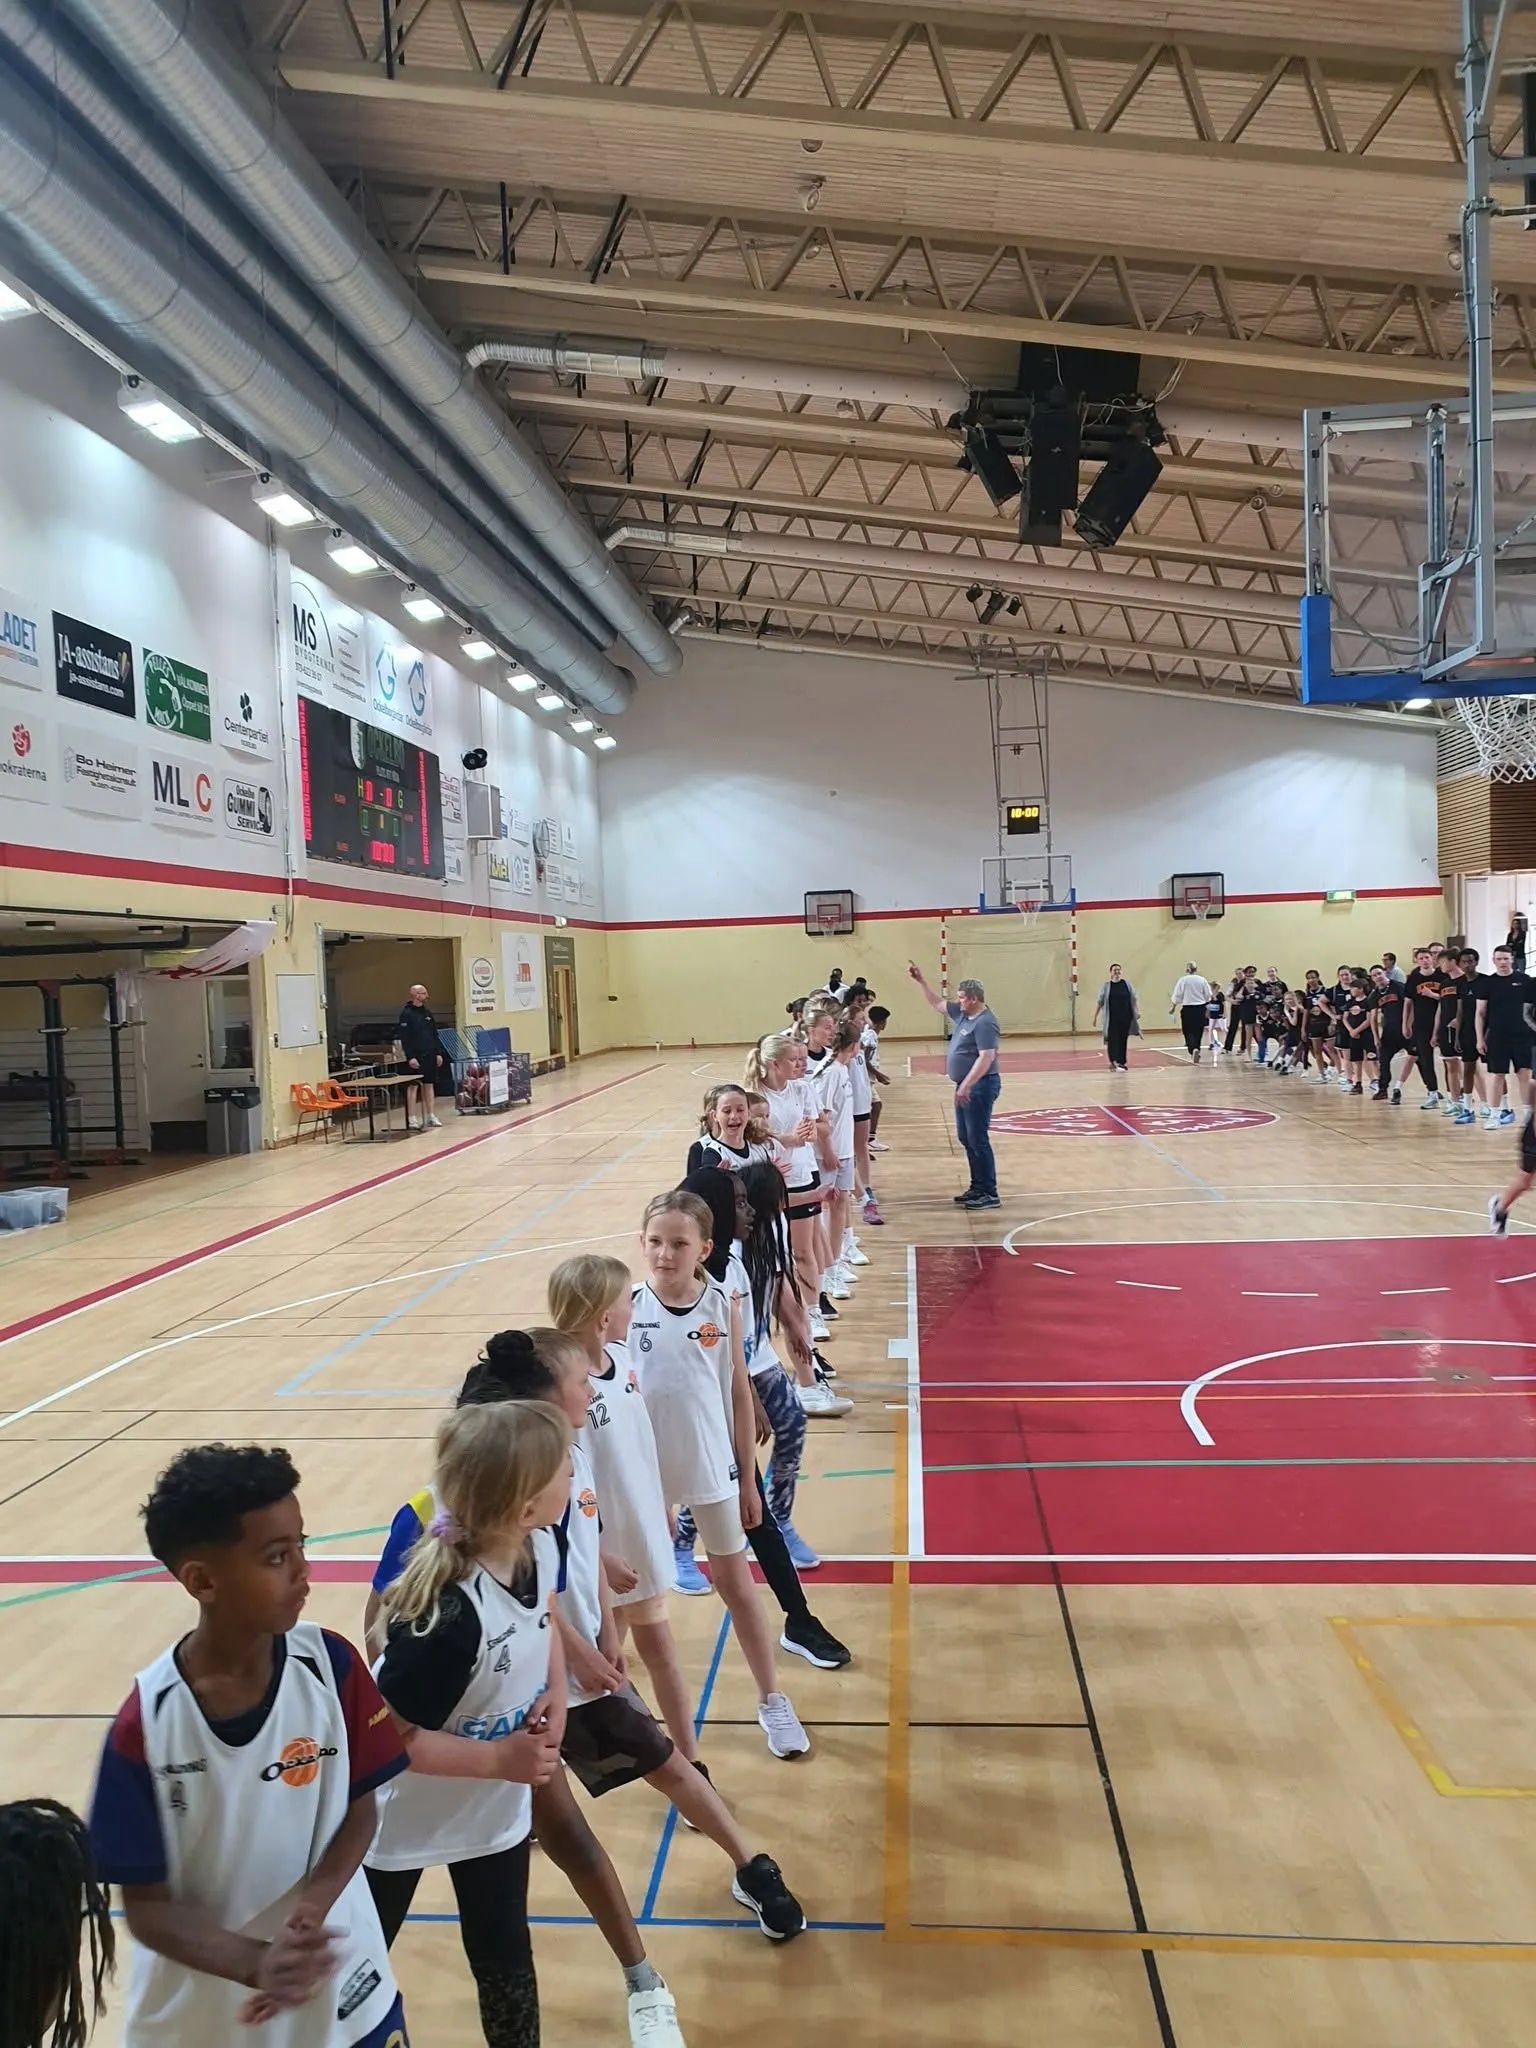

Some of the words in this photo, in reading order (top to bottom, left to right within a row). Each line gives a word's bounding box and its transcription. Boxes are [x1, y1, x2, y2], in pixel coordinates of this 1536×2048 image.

[293, 603, 317, 651] MS
[58, 632, 121, 680] JA-assistans
[223, 717, 269, 744] Centerpartiet
[76, 753, 94, 766] Bo
[227, 791, 256, 819] GUMMI
[639, 1331, 652, 1352] 6
[586, 1403, 611, 1430] 12
[493, 1644, 512, 1675] 4
